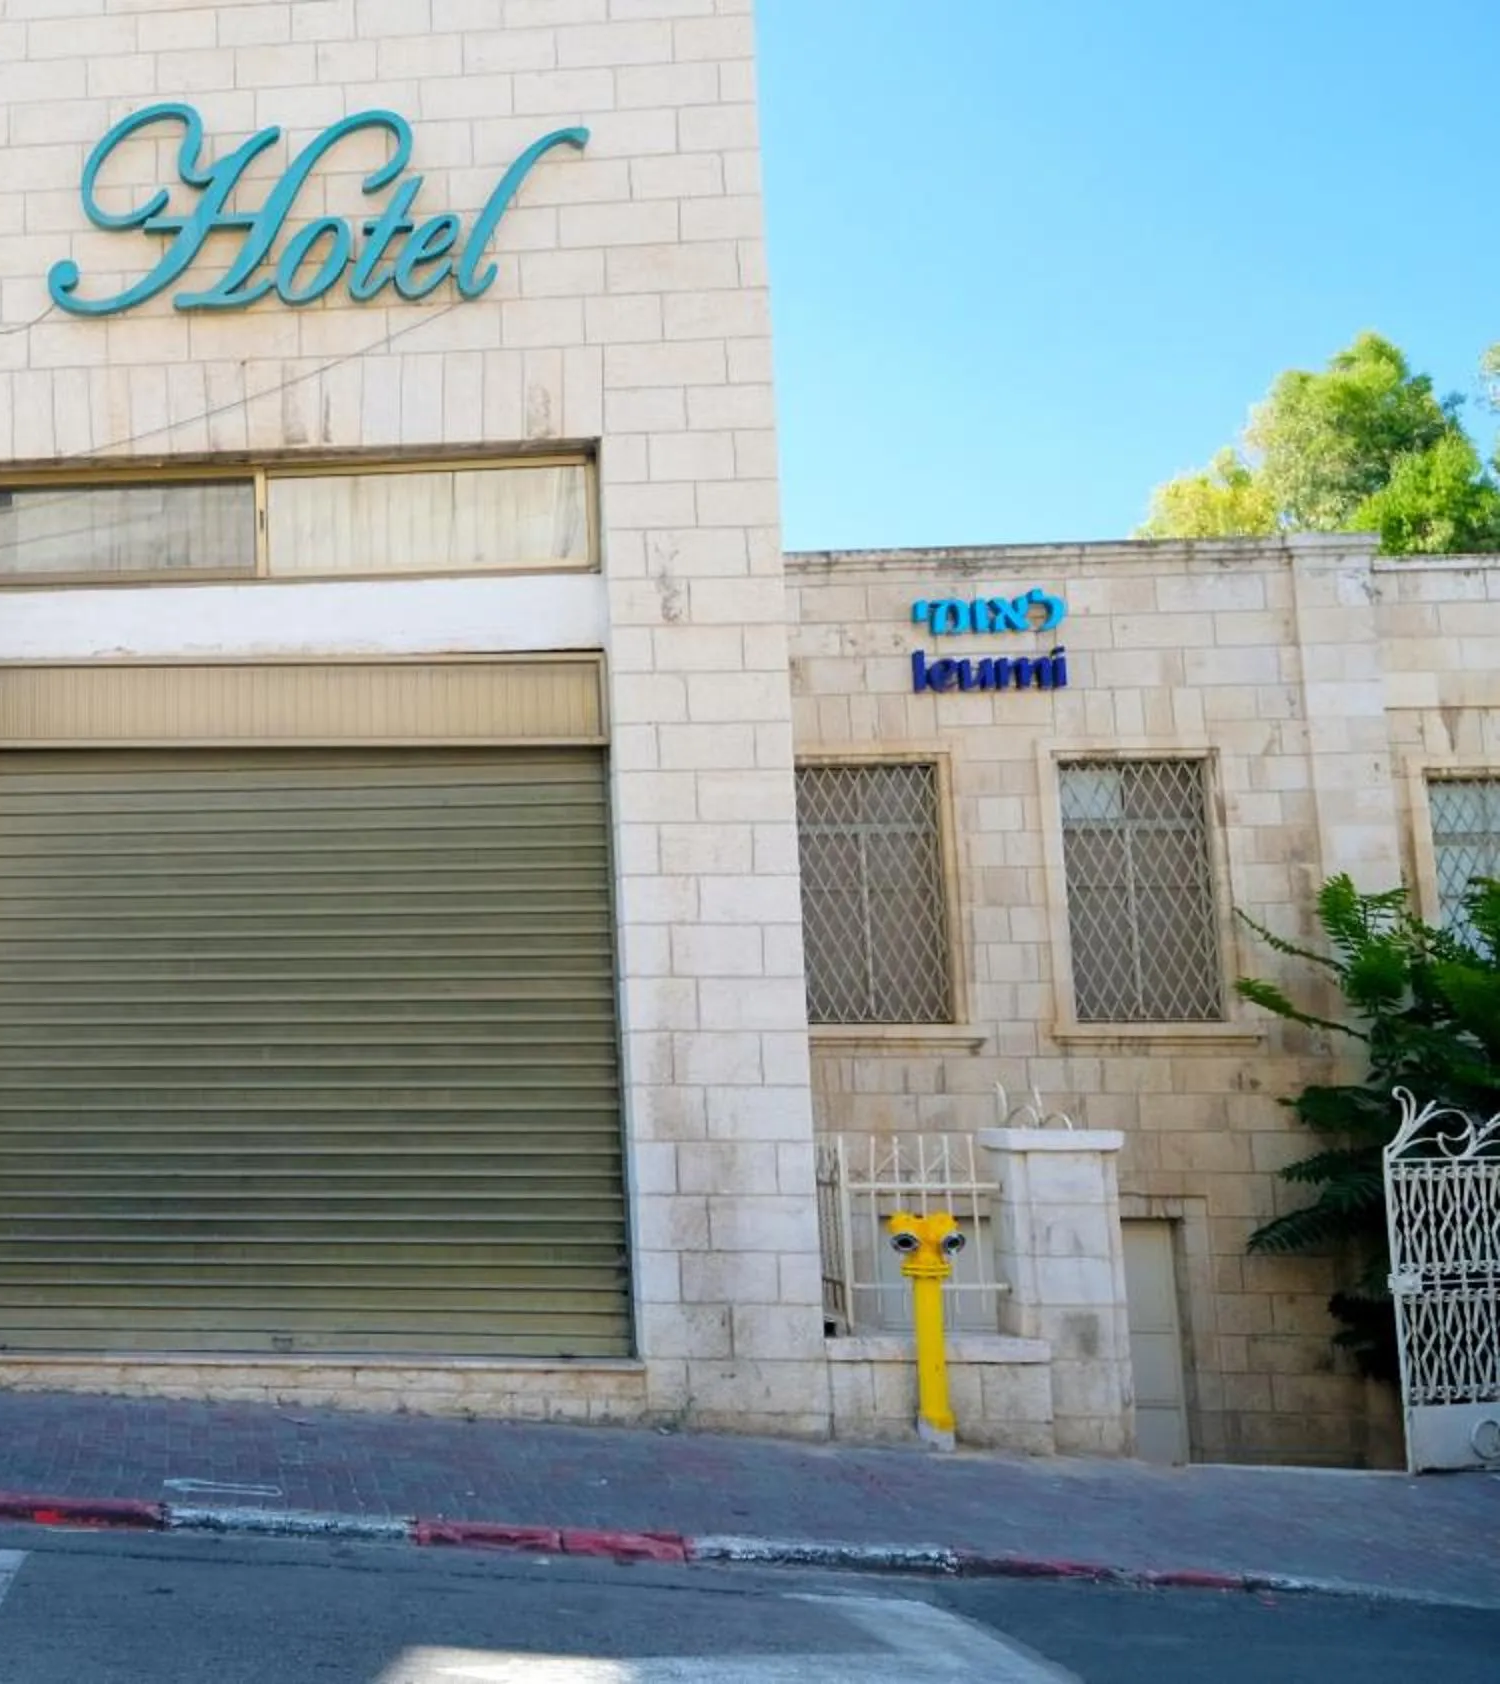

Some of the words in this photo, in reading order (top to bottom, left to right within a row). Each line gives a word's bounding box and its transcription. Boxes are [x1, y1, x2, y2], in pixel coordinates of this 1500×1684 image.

[48, 102, 589, 316] Hotel
[911, 586, 1067, 636] לאומי
[911, 646, 1067, 693] leumi
